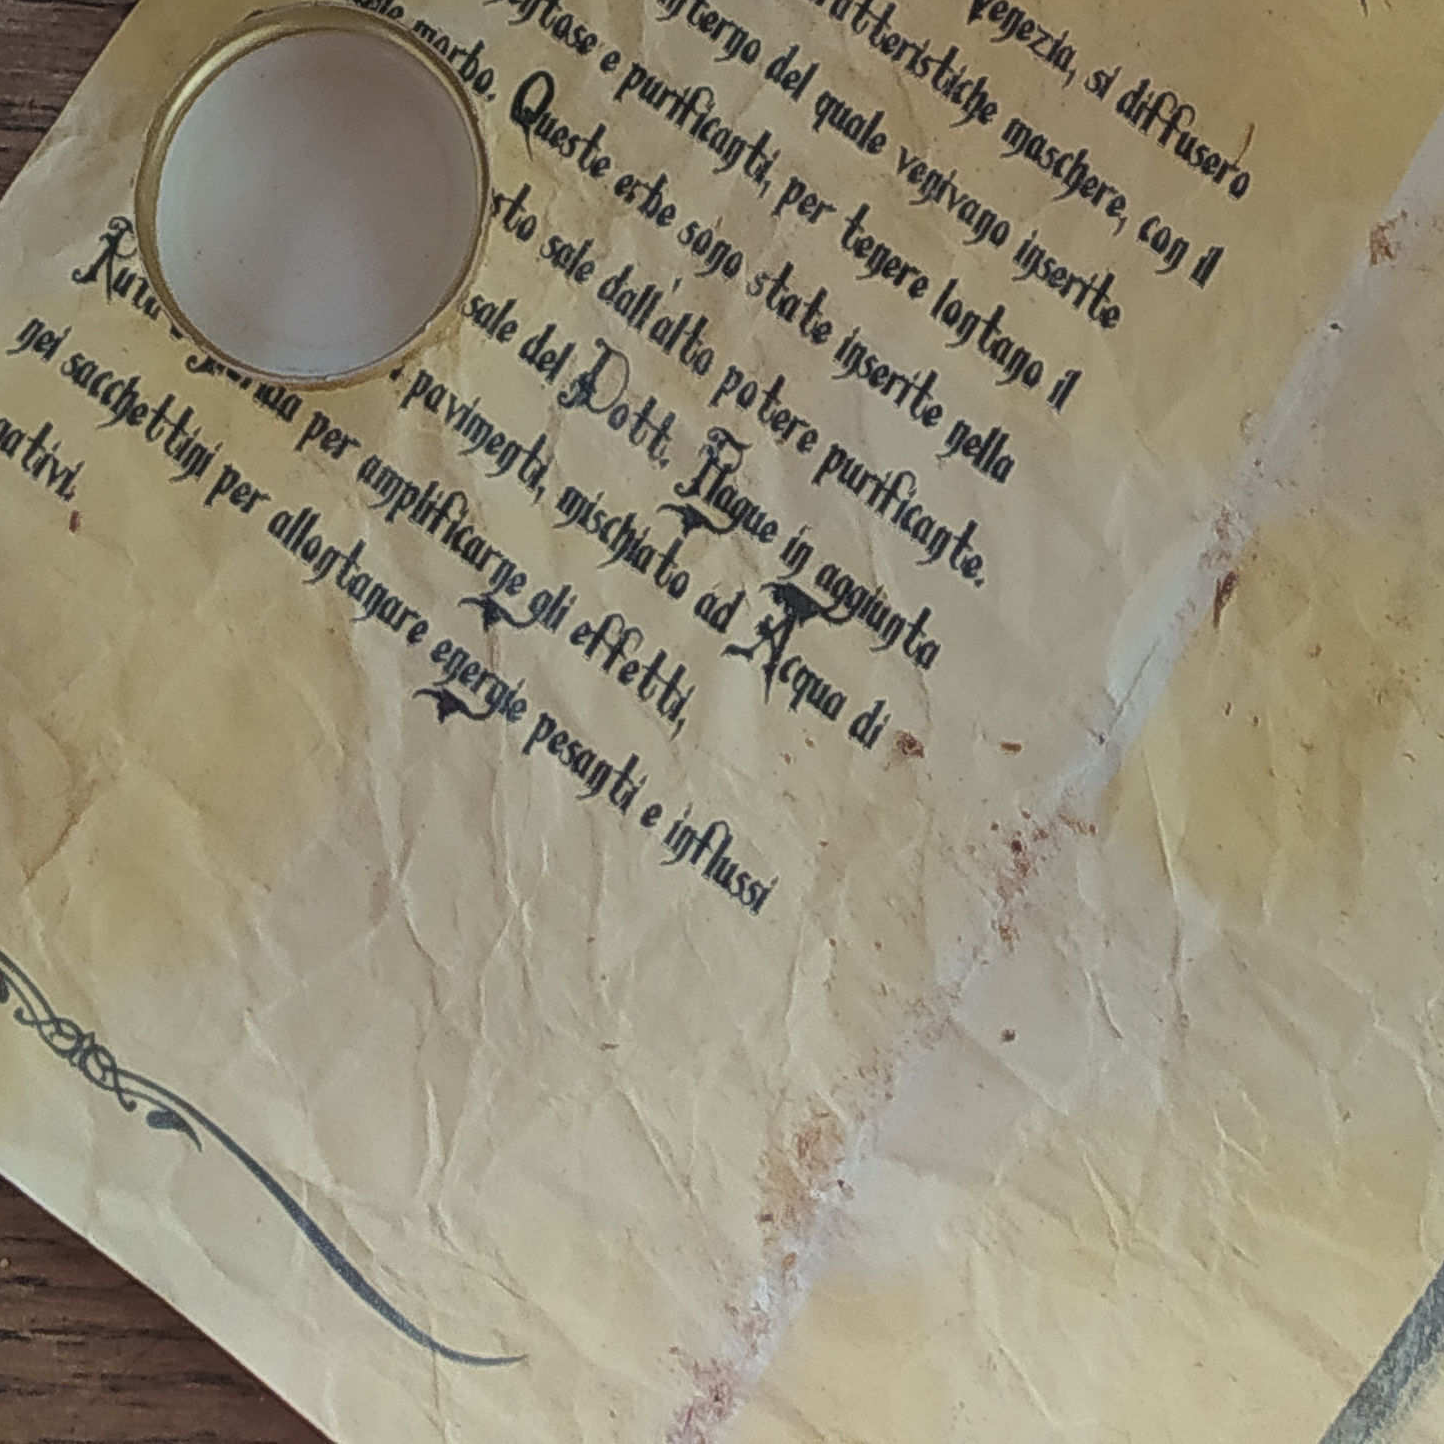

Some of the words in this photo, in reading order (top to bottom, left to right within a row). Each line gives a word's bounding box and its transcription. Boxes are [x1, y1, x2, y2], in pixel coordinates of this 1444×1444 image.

[763, 43, 820, 102] del
[811, 89, 887, 155] quale
[896, 144, 1010, 248] venivano
[1010, 229, 1121, 329] inserite
[1082, 65, 1122, 101] si
[1114, 77, 1251, 200] diffusero
[598, 49, 621, 74] e
[612, 61, 781, 199] purificanti,
[769, 175, 838, 225] per
[839, 202, 930, 300] tenere
[929, 277, 1044, 390] lontano
[1045, 368, 1083, 414] il
[999, 117, 1128, 236] maschere,
[1136, 214, 1190, 275] con
[1188, 245, 1225, 289] il
[459, 294, 519, 344] sale
[508, 69, 611, 179] Queste
[676, 220, 744, 279] sono
[745, 260, 833, 345] state
[830, 325, 943, 428] inserite
[934, 418, 1015, 484] nella
[517, 322, 576, 385] del
[538, 234, 595, 285] sale
[707, 364, 819, 454] potere
[810, 442, 984, 588] purificante.
[555, 336, 676, 469] Dott.
[398, 368, 555, 504] pavimenti,
[292, 410, 362, 460] per
[355, 453, 527, 599] amplificarne
[524, 583, 577, 634] gli
[568, 612, 696, 741] effetti,
[551, 485, 690, 600] mischiato
[776, 524, 814, 591] in
[5, 316, 72, 362] nei
[59, 352, 224, 482] sacchettini
[203, 462, 271, 514] per
[266, 506, 429, 646] allontanare
[429, 638, 527, 723] energie
[520, 711, 648, 816] pesanti
[639, 802, 663, 828] e
[659, 802, 779, 916] influssi
[692, 589, 747, 635] ad
[719, 590, 848, 722] Acqua
[790, 562, 941, 671] aggiunta
[847, 698, 891, 750] di
